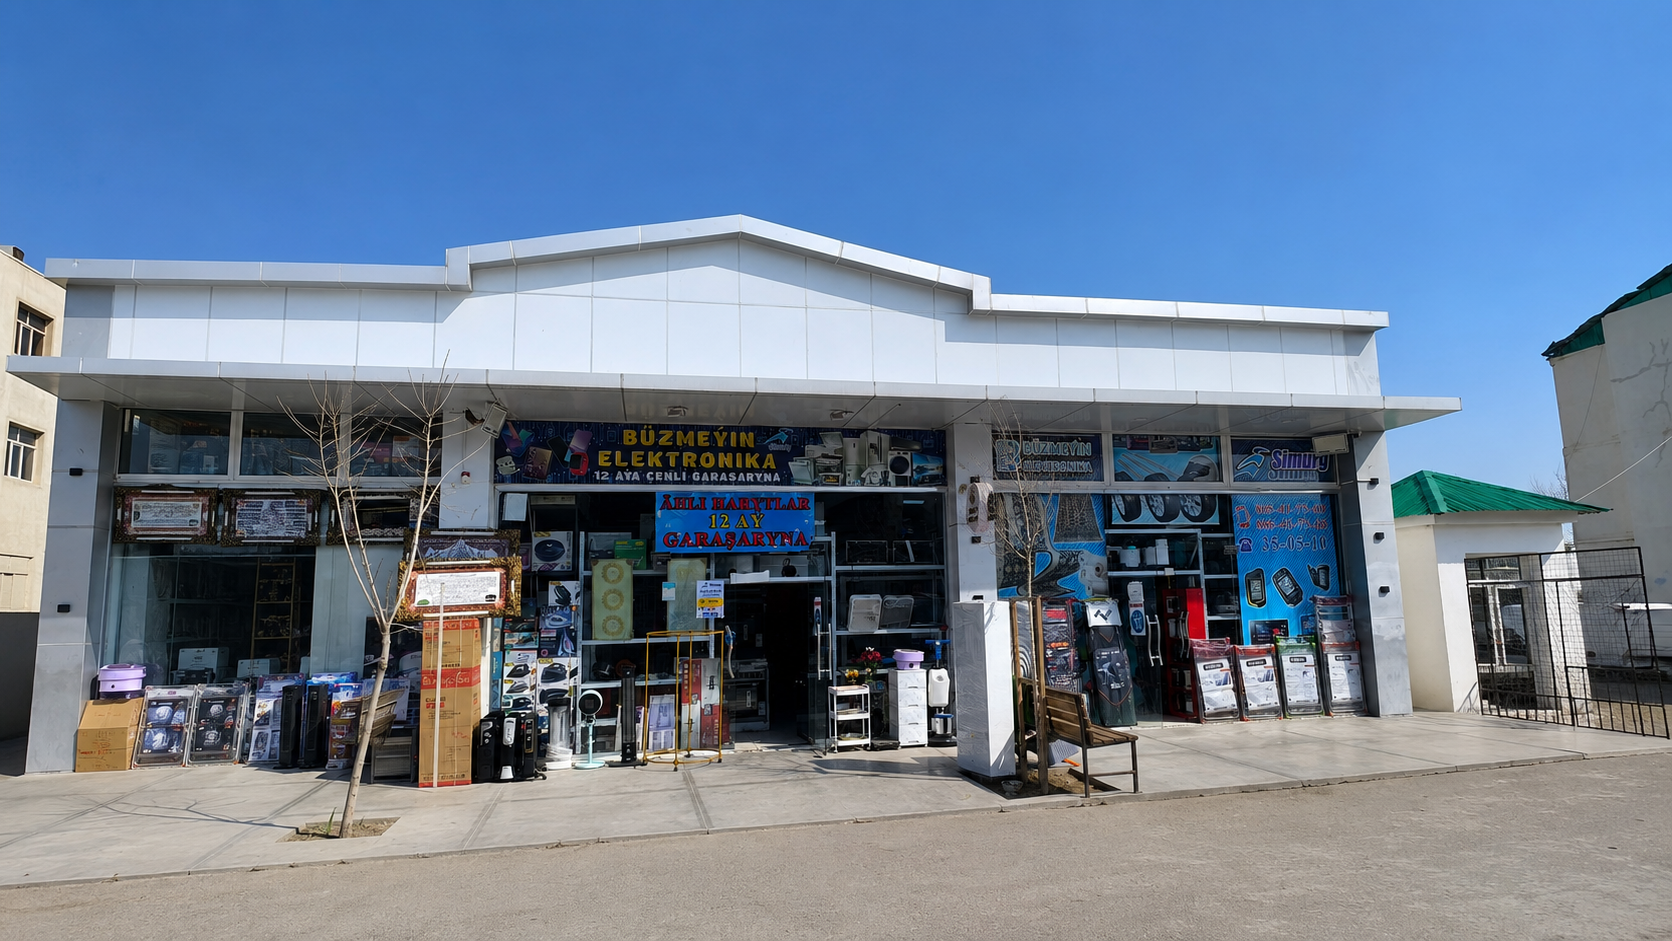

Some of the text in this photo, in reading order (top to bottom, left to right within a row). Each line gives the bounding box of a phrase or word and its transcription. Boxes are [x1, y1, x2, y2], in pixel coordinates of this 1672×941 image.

[623, 425, 755, 448] BÜZMEÝIN
[598, 450, 777, 469] ELEKTRONIKA
[594, 470, 609, 480] 12
[709, 513, 731, 529] 12
[663, 531, 810, 551] GARAŞARYNA
